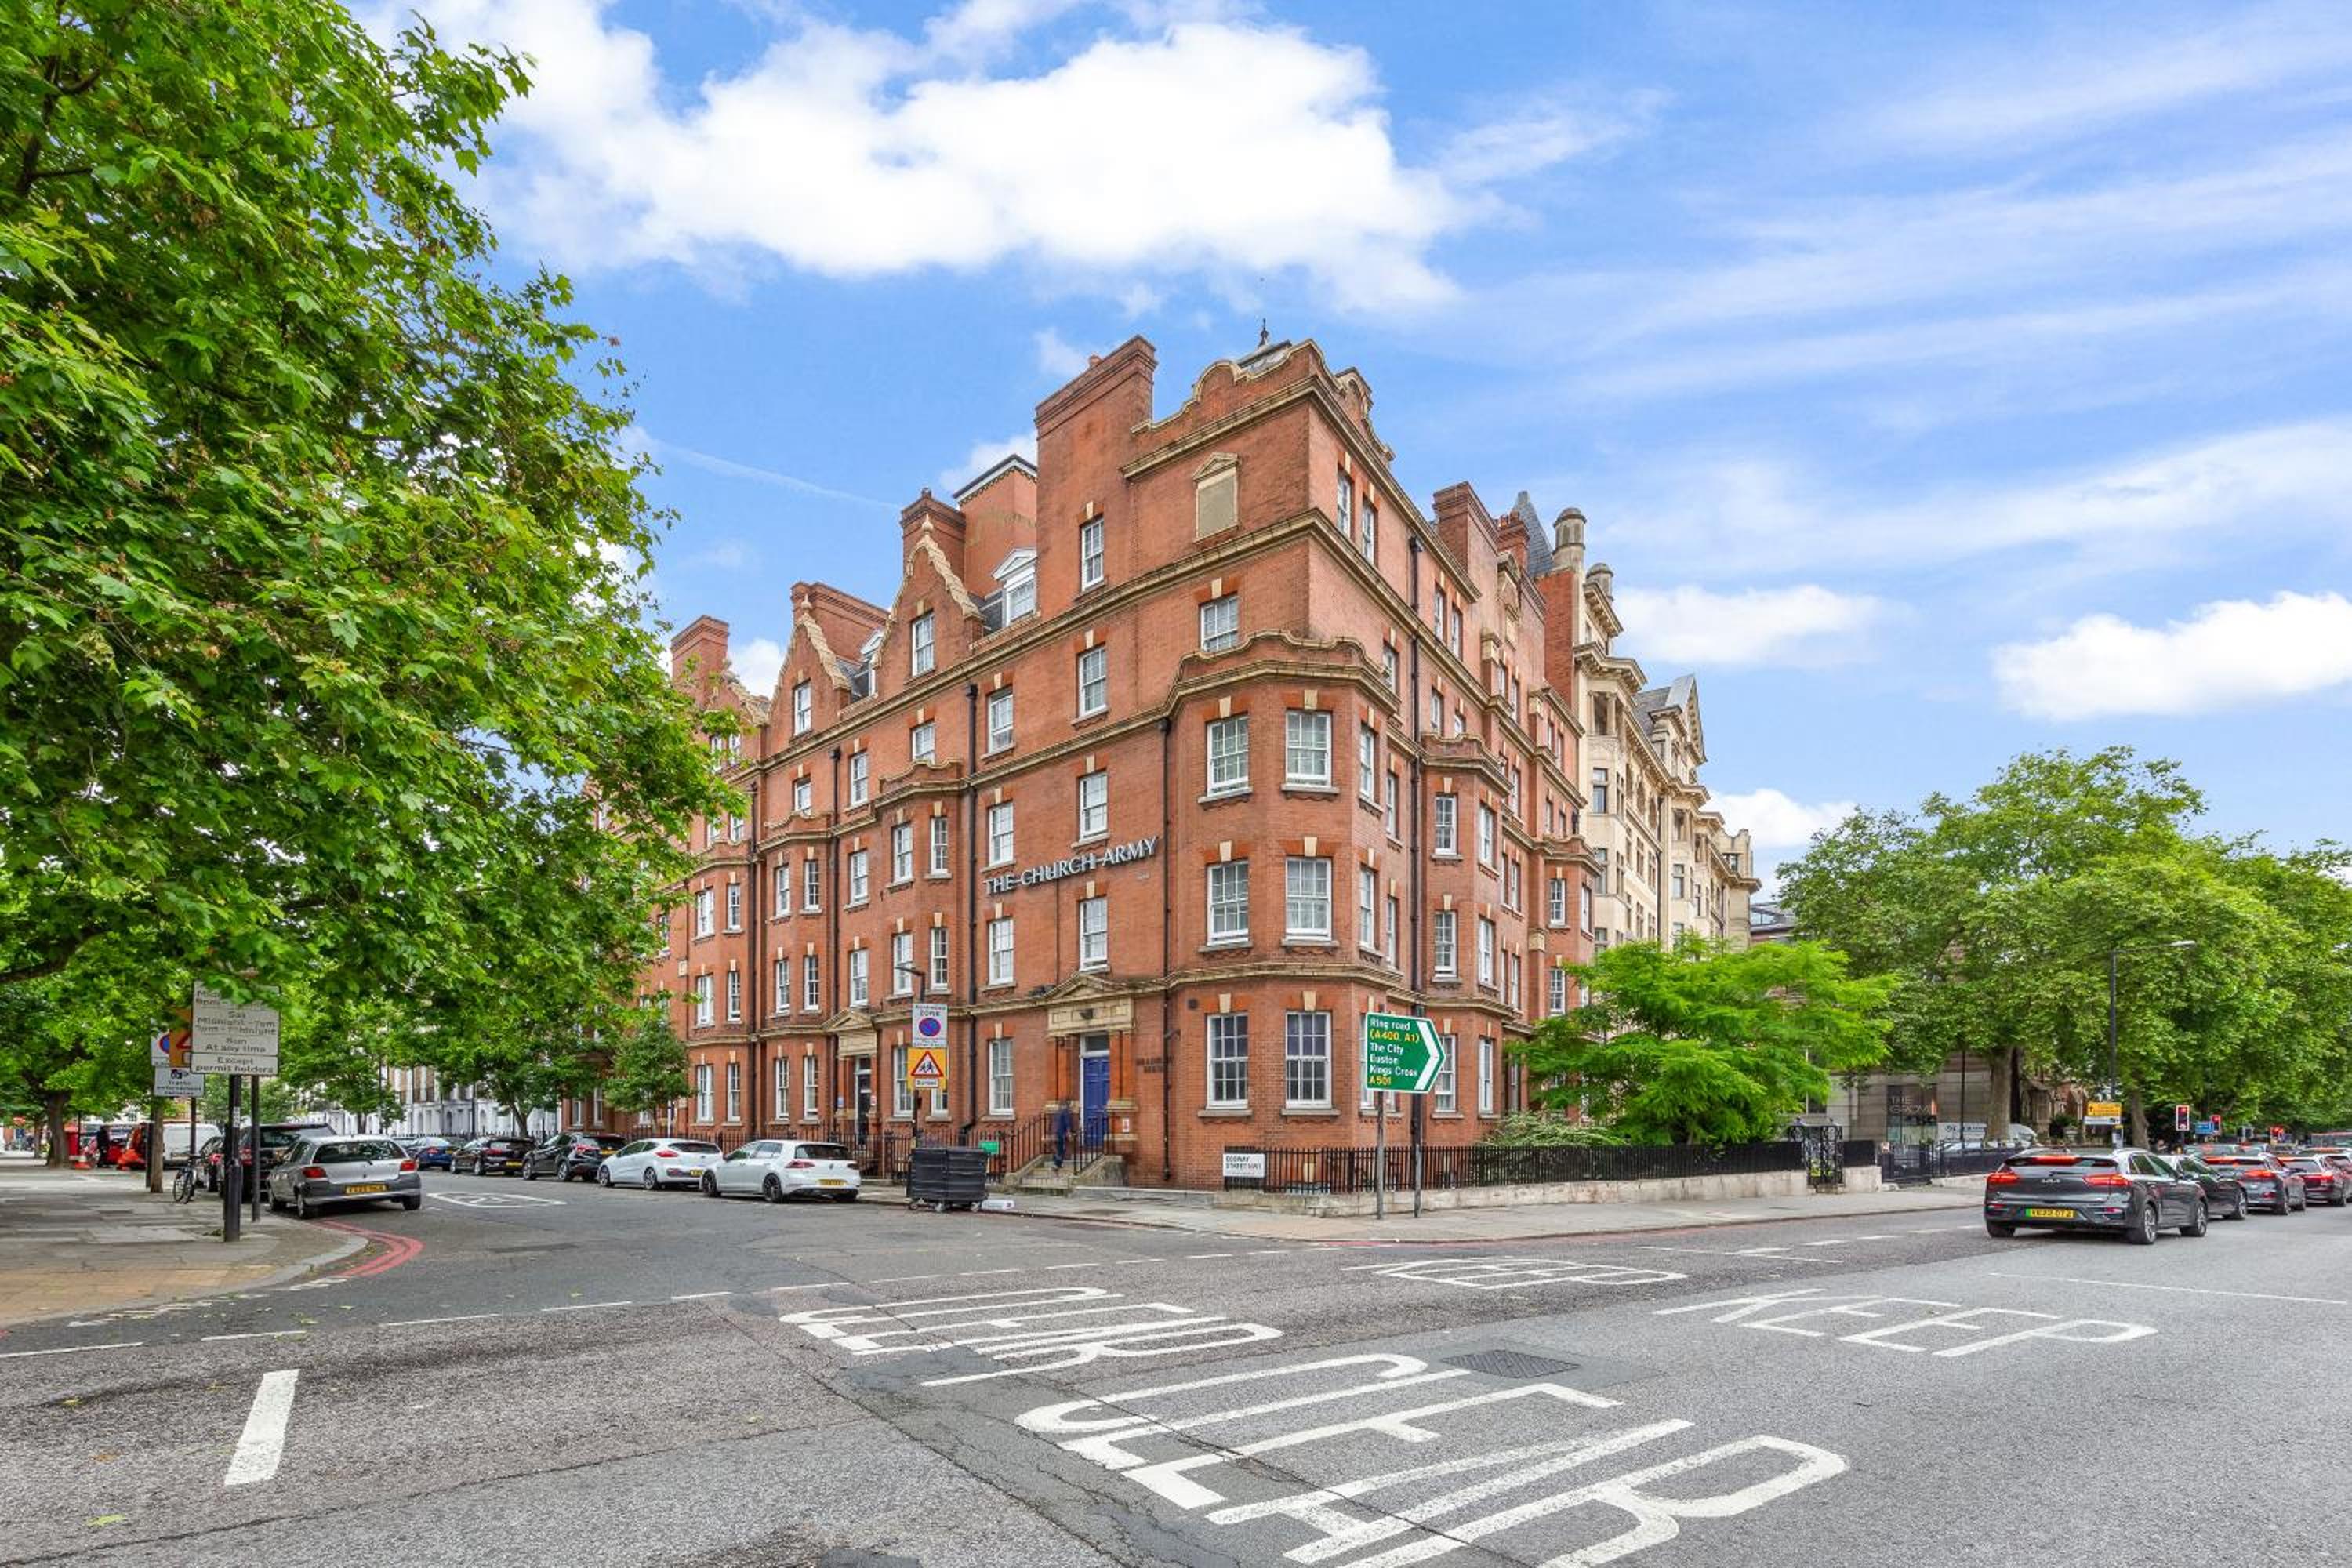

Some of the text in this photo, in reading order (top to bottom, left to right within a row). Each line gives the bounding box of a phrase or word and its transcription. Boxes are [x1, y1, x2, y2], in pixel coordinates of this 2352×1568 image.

[983, 837, 1157, 895] THE CHURCH ARMY
[1370, 1018, 1410, 1031] Ring road
[1370, 1042, 1403, 1055] The City
[1370, 1054, 1399, 1064] Euston
[1395, 1066, 1417, 1076] Cross
[1653, 1288, 2157, 1356] KEEP
[1014, 1352, 1849, 1568] CLEAR
